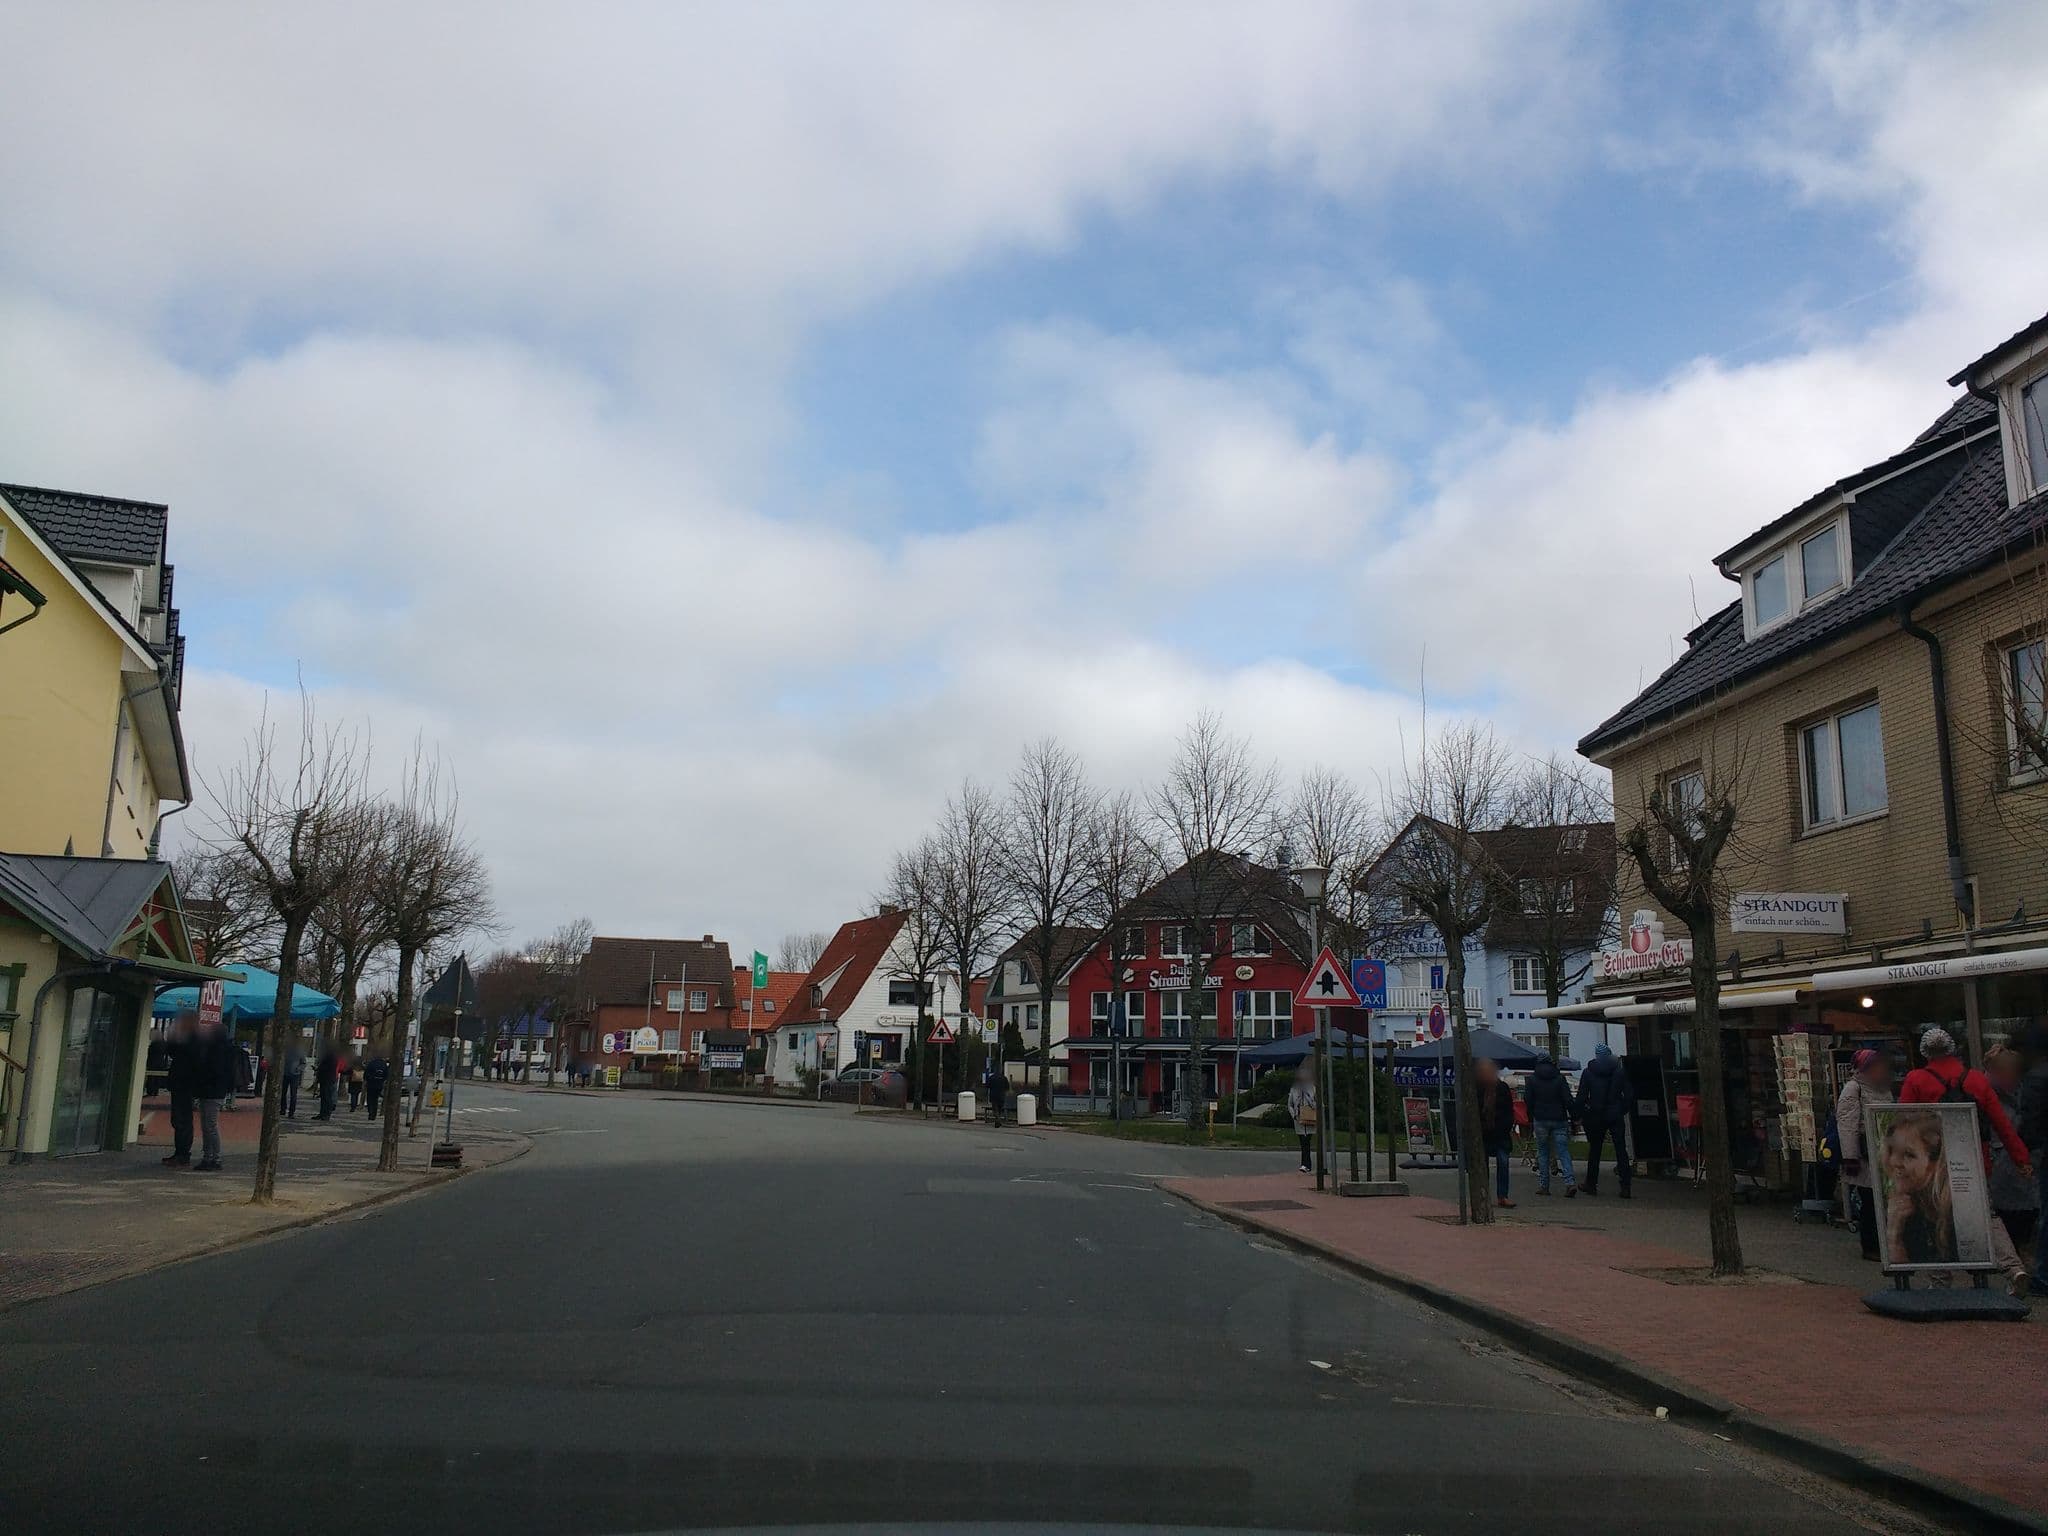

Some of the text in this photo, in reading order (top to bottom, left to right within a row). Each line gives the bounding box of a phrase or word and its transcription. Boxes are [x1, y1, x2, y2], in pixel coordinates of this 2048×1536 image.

[1744, 899, 1838, 913] STRANDGUT
[1744, 916, 1776, 926] einfach
[1888, 962, 1948, 979] STRANDGUT
[1357, 993, 1384, 1005] TAXI
